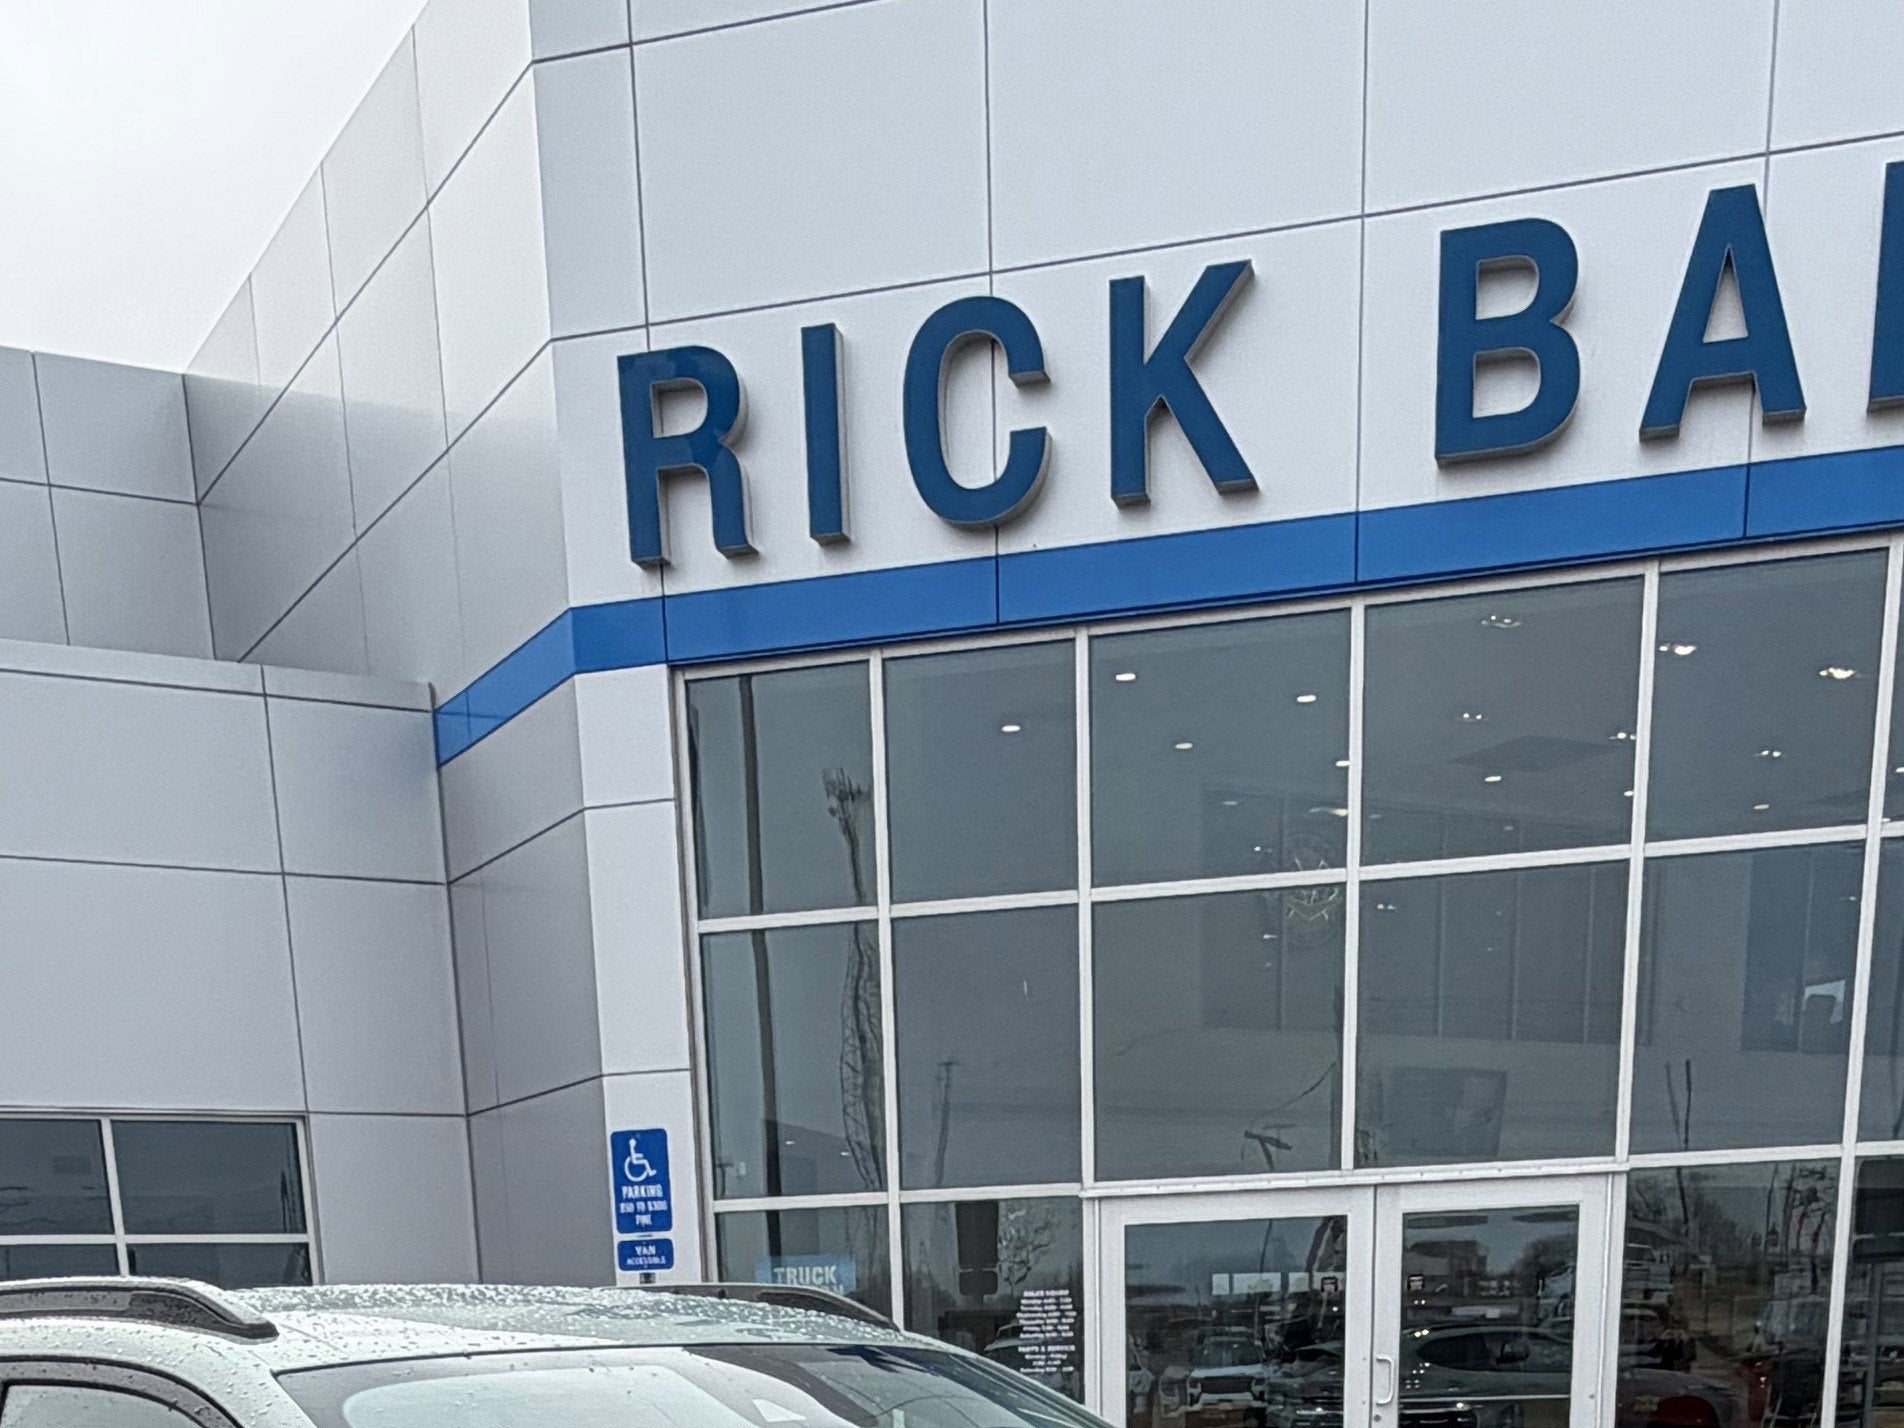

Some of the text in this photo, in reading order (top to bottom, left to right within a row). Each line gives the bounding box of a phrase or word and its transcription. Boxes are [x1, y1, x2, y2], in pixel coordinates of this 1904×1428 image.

[617, 261, 1259, 571] RICK
[622, 1184, 663, 1200] PARKING
[635, 1245, 656, 1255] VAN
[773, 1265, 837, 1286] TRUCK
